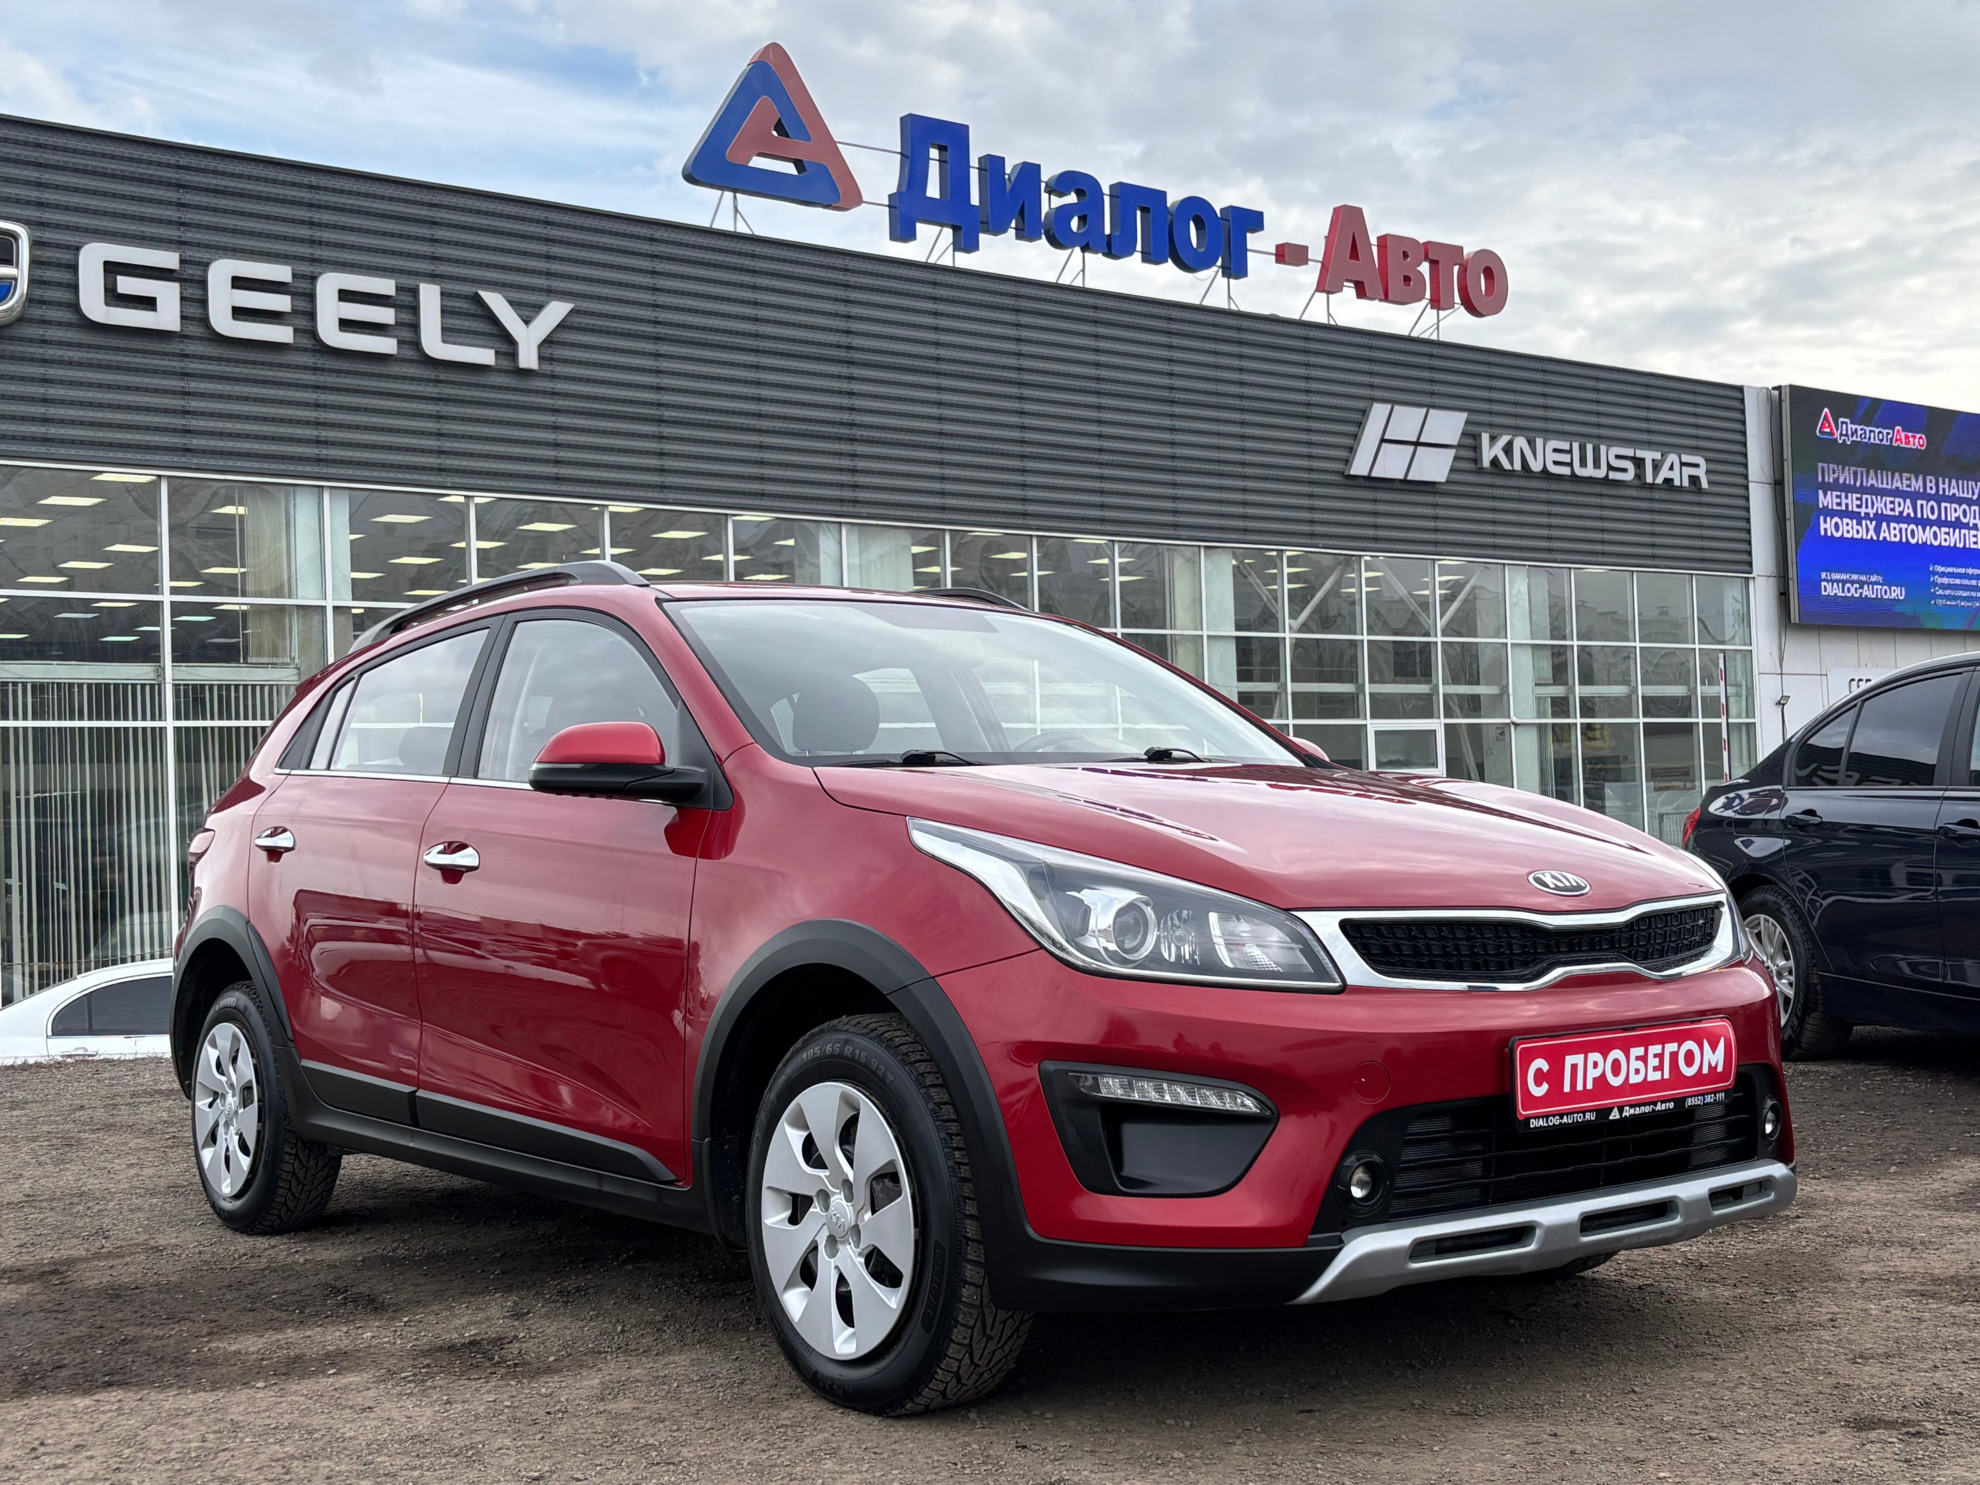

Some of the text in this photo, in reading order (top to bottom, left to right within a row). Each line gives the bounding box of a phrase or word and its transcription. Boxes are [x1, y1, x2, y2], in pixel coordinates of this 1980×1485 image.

[78, 241, 575, 371] GEELY
[1479, 432, 1709, 488] KNEWSTAR
[1817, 462, 1923, 493] ПРИГЛАШАЕМ
[1926, 475, 1936, 494] В
[1818, 490, 1914, 518] МЕНЕДЖЕРА
[1917, 500, 1938, 520] ПО
[1820, 516, 1980, 549] НОВЫХ АВТОМОБИЛЕ
[1821, 582, 1905, 599] DIALOG-AUTO.RU
[802, 1043, 841, 1062] 185/65
[1527, 1037, 1725, 1097] С ПРОБЕГОМ
[1622, 1101, 1674, 1118] Диалог-Авто
[1704, 1091, 1725, 1104] 382-111
[1530, 1111, 1596, 1129] DIALOG-AUTO.RU
